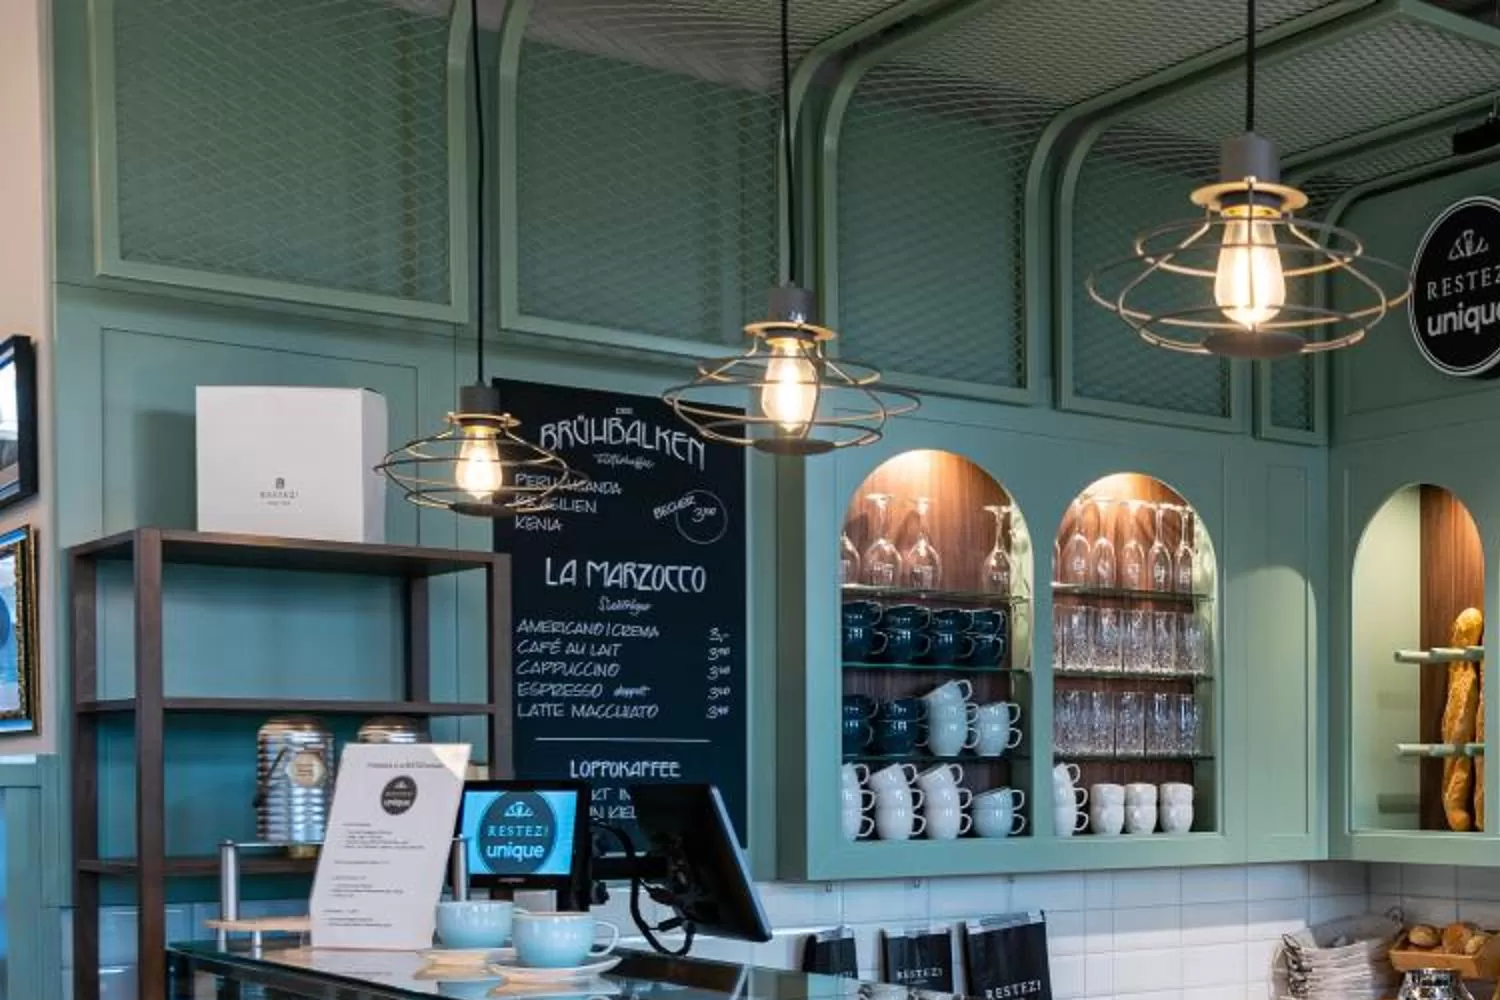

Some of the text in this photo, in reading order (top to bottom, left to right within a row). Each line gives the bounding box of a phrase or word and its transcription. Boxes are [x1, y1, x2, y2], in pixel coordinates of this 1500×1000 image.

[540, 414, 705, 471] BRÜHBALKEN
[515, 516, 563, 533] KENIA
[545, 557, 706, 593] LA MARZOCCO
[516, 639, 562, 656] CAFÉ
[565, 643, 586, 656] AU
[590, 643, 623, 657] LAIT
[516, 660, 621, 677] CAPPUCCINO
[517, 683, 603, 699] ESPRESSO
[517, 704, 565, 718] LATTE
[571, 705, 660, 719] MACCHIATO
[570, 760, 681, 779] LOPPOKAFFEE
[487, 825, 549, 837] RESTEZ!
[486, 841, 545, 862] unique
